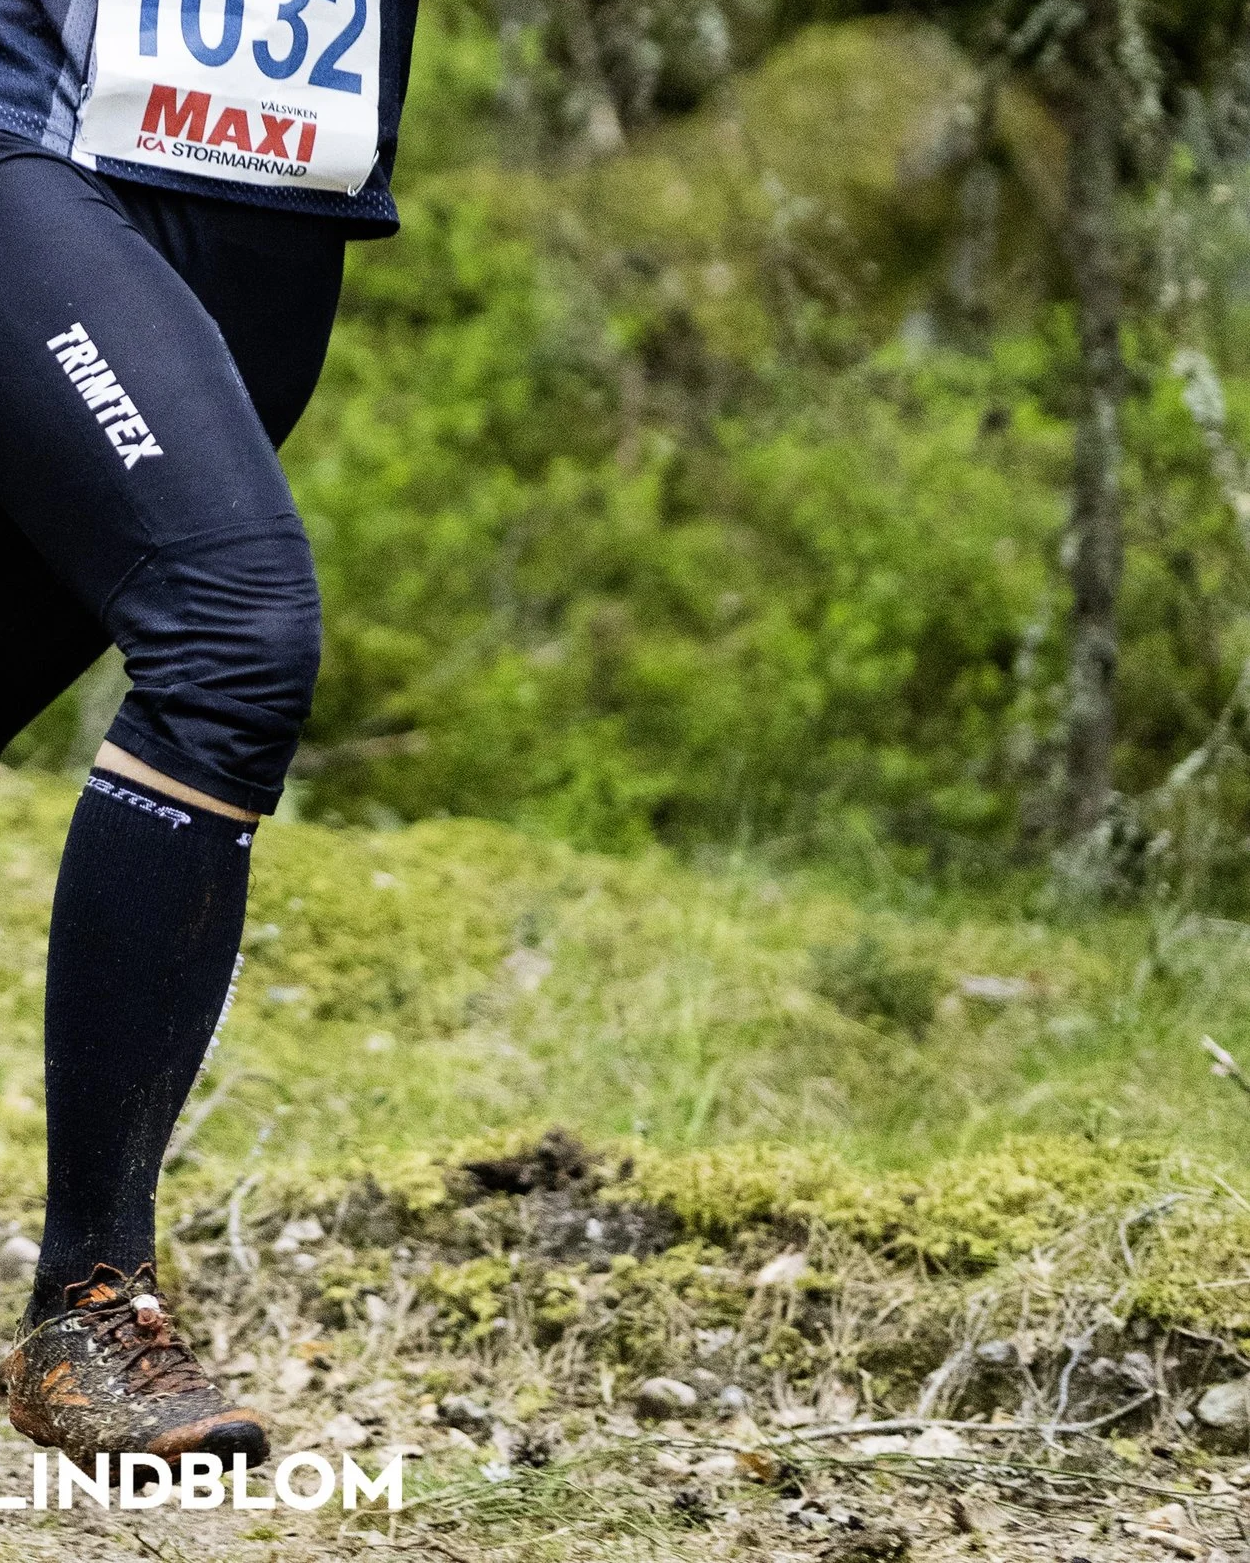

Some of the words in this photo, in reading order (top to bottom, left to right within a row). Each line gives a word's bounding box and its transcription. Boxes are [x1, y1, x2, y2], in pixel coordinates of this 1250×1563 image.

[141, 83, 317, 163] MAXI
[261, 100, 318, 120] VÄLSVIKEN
[136, 135, 167, 154] ICA
[171, 141, 308, 178] STORMARKNAD
[46, 321, 164, 471] TRIMTEX
